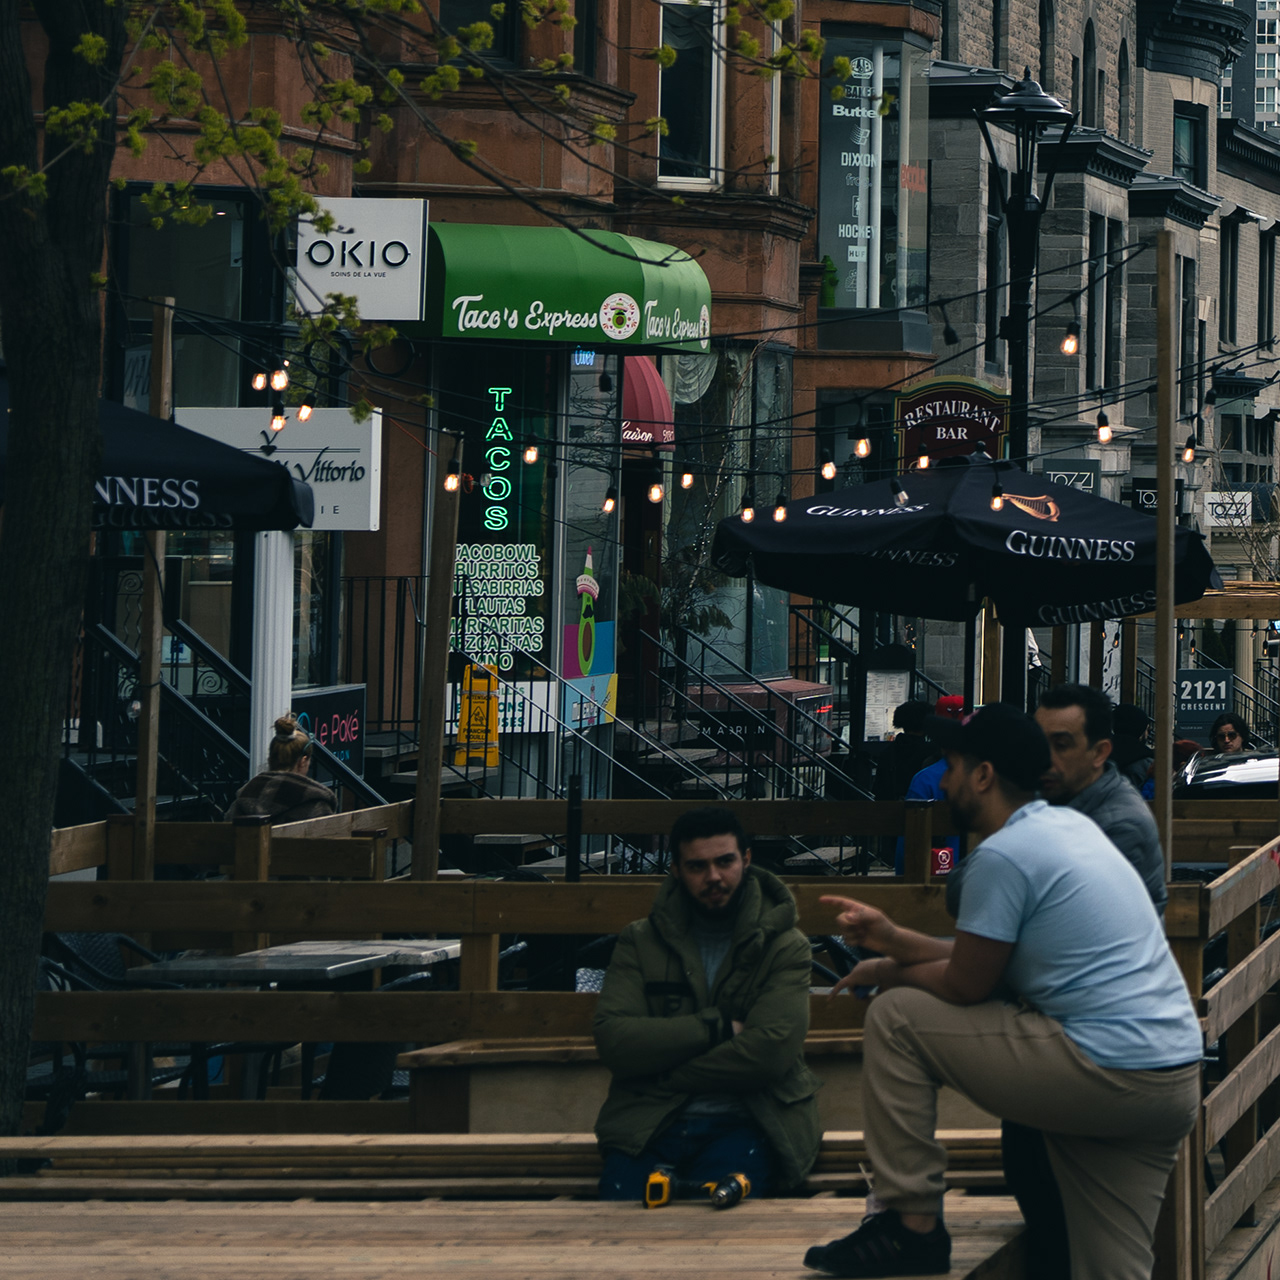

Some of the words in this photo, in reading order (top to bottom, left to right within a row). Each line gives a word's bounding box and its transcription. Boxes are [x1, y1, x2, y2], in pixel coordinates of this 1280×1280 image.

[838, 224, 876, 239] HOCKEY
[305, 240, 411, 268] OKIO
[451, 294, 519, 332] Taco's
[525, 300, 598, 336] Express
[644, 299, 671, 339] Taco's
[671, 308, 699, 345] Express
[904, 400, 1001, 433] RESTAURANT
[936, 426, 968, 440] BAR
[293, 447, 365, 482] Vittorio
[483, 387, 513, 531] TACOS
[455, 543, 541, 561] TACOBOWL
[1005, 529, 1135, 562] GUINNESS
[454, 561, 539, 579] BURRITOS
[1181, 680, 1226, 700] 2121
[1181, 703, 1226, 711] CRESCENT
